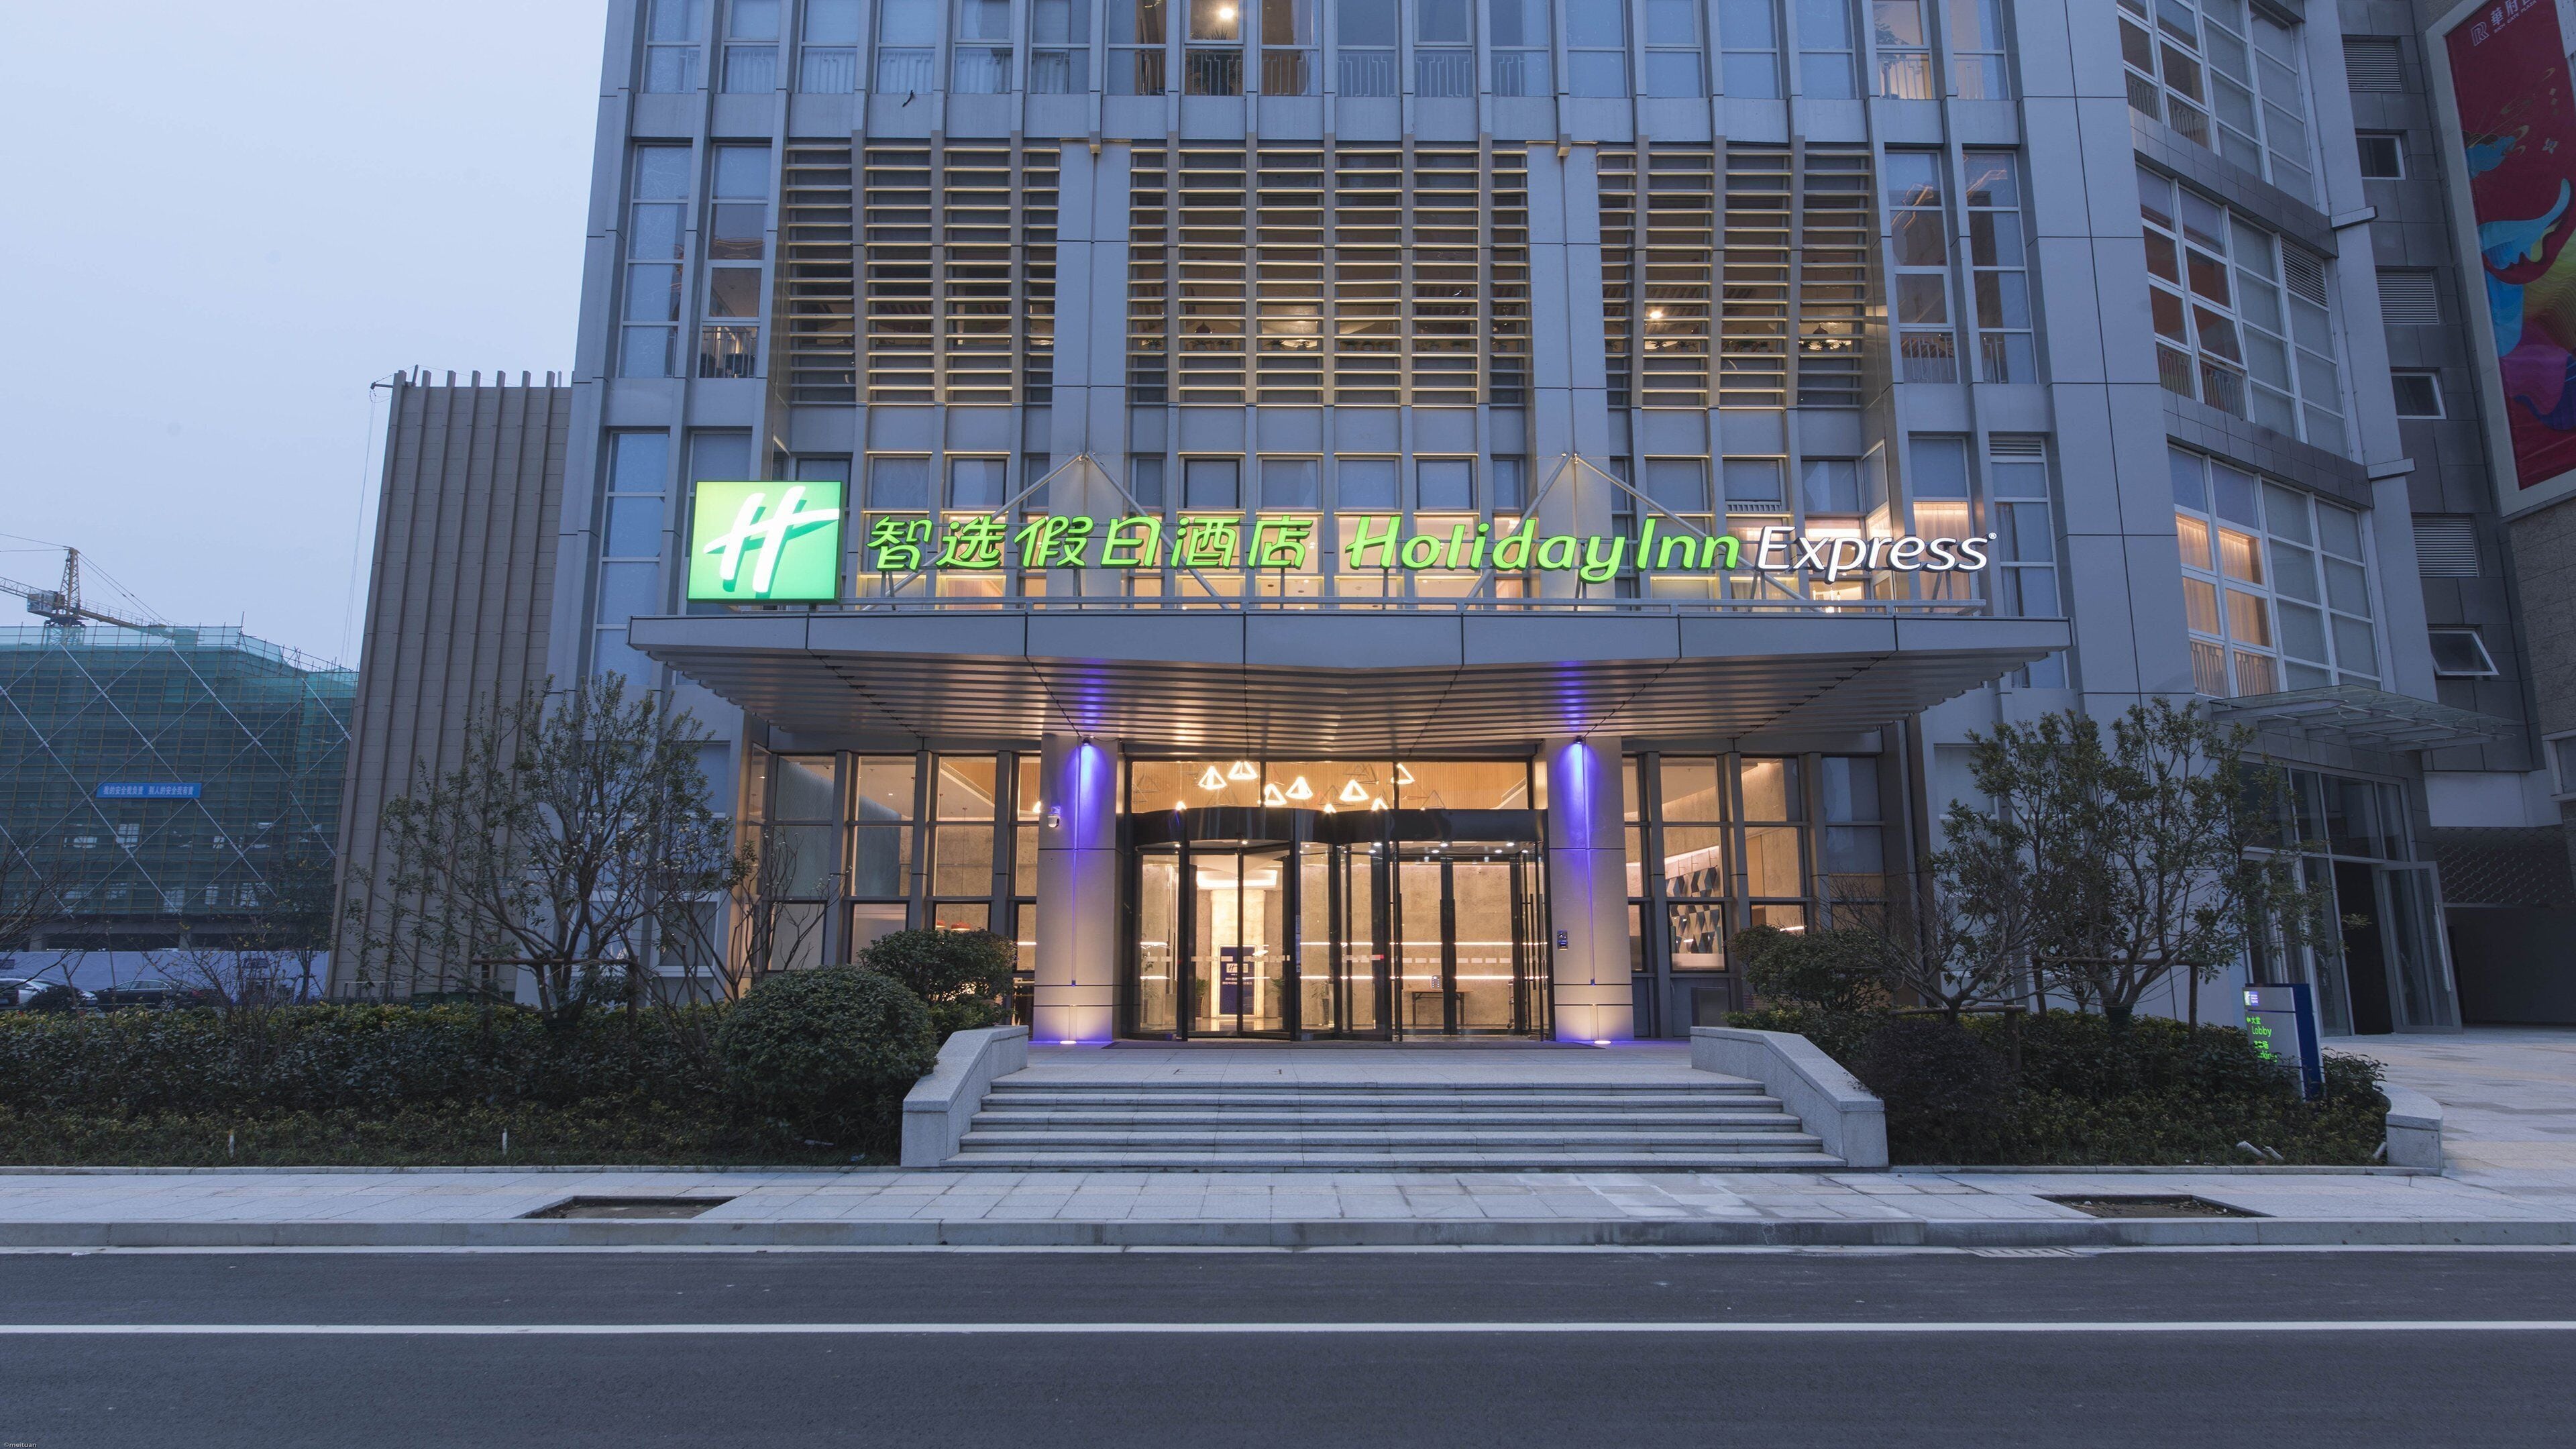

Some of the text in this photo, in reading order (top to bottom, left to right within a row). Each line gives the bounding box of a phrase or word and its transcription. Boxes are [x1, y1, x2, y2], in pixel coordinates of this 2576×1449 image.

[867, 515, 1313, 570] 智选假日酒店
[2251, 1026, 2272, 1037] Lobby
